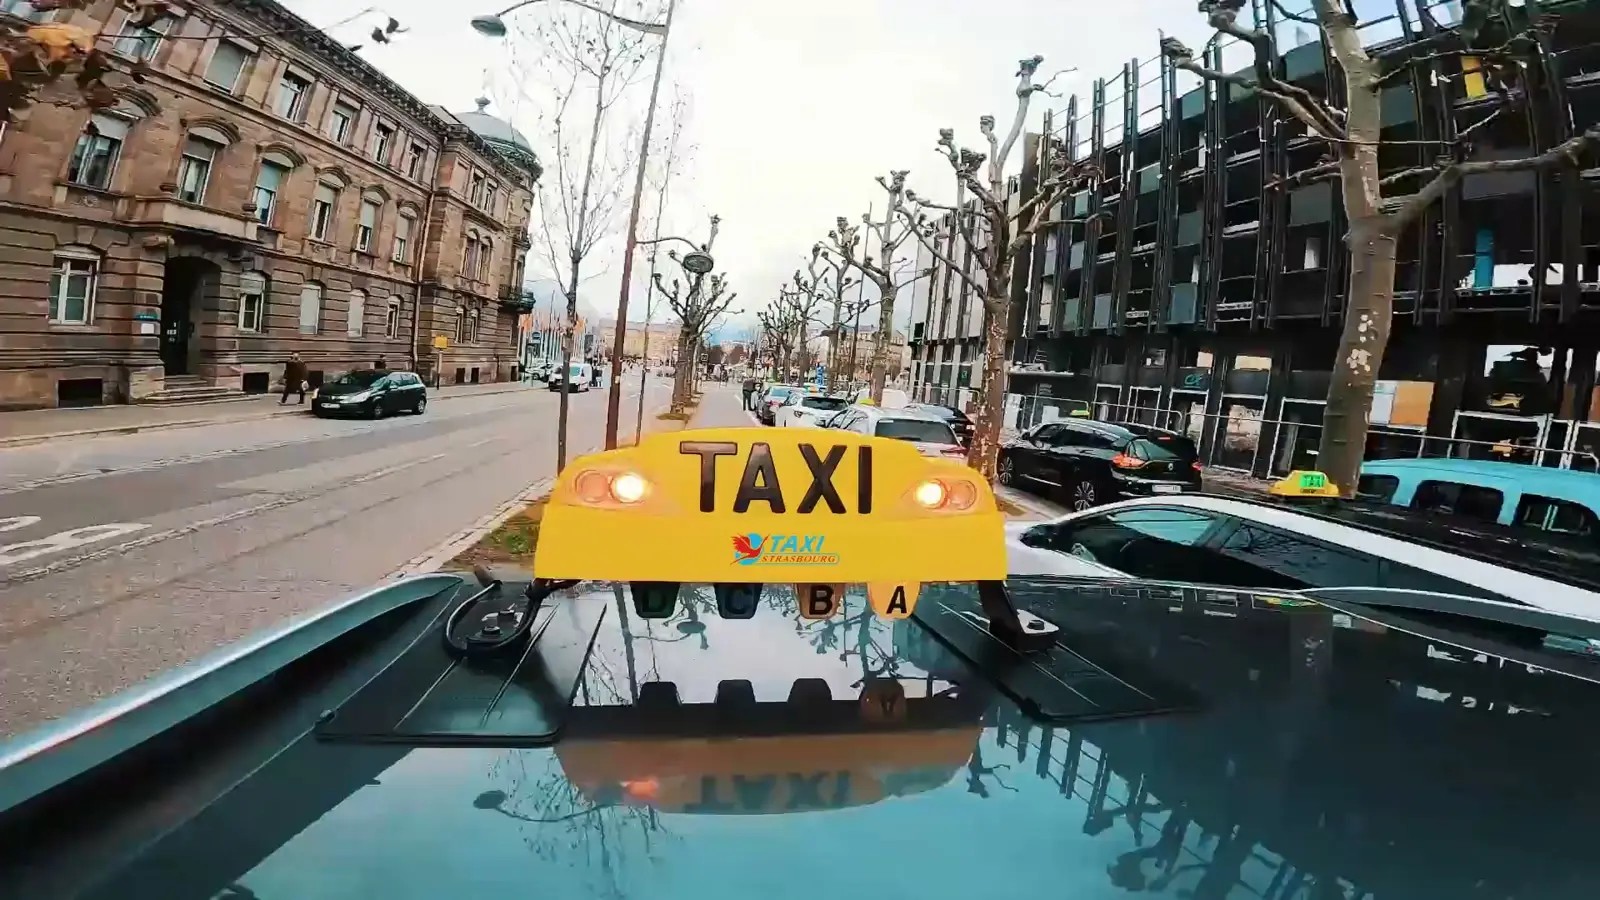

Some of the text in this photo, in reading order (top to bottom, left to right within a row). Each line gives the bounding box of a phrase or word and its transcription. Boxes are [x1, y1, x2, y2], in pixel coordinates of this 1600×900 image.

[679, 440, 873, 515] TAXI
[770, 535, 825, 553] TAXI
[761, 555, 837, 563] STRASBOURG
[808, 584, 834, 615] B
[885, 585, 907, 614] A
